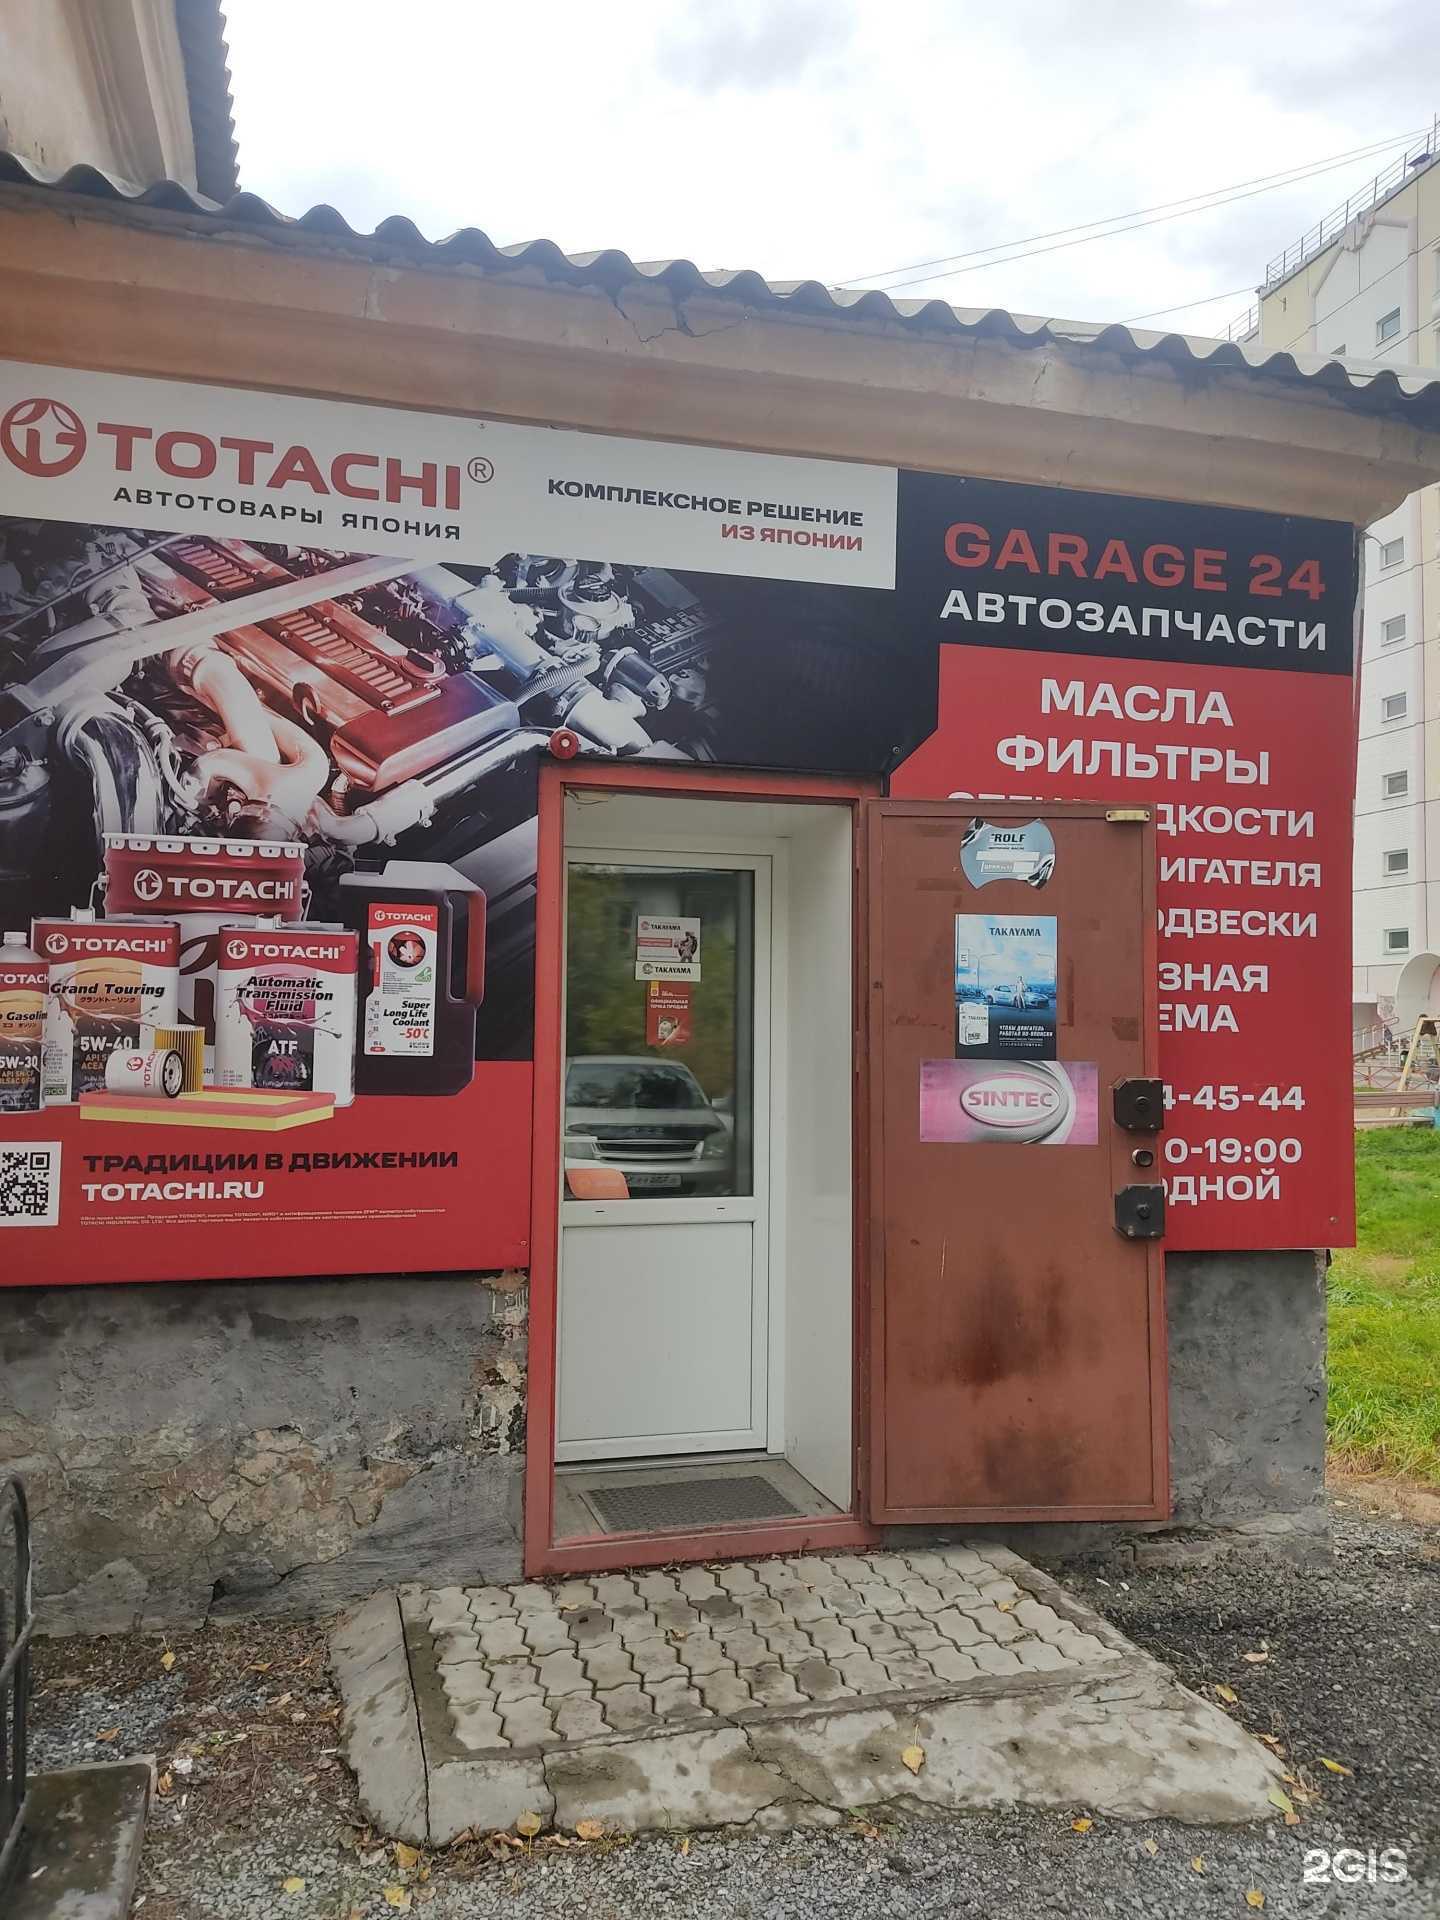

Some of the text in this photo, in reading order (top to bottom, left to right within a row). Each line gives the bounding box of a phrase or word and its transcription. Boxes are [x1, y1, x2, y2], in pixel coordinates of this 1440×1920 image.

[548, 478, 863, 527] КОМПЛЕКСНОЕ РЕШЕНИЕ
[114, 487, 461, 541] АВТОТОВАРЫ ЯПОНИЯ
[721, 523, 863, 552] ИЗ ЯПОНИИ
[944, 522, 1326, 600] GARAGE 24
[939, 589, 1327, 652] АВТОЗАПЧАСТИ
[1041, 678, 1234, 728] МАСЛА
[996, 735, 1270, 786] ФИЛЬТРЫ
[992, 833, 1027, 843] ROLF
[167, 877, 294, 900] TOTACHI
[387, 912, 431, 921] TOTACHI
[1158, 908, 1317, 939] ДВЕСКИ
[989, 927, 1042, 937] TAKAYAMA
[72, 938, 166, 953] TOTACHI
[250, 943, 340, 960] TOTACHI
[654, 966, 692, 974] TAKAYAMA
[50, 983, 165, 998] Grand Touring
[247, 976, 324, 989] Automatic
[236, 988, 333, 1001] Transmission
[266, 1000, 303, 1011] Fluid
[401, 1001, 430, 1010] Super
[383, 1009, 428, 1019] Long Life
[393, 1018, 430, 1027] Coolant
[80, 1036, 133, 1052] 5W-40
[268, 1040, 298, 1055] ATF
[968, 1090, 1053, 1108] SINTEC
[83, 1152, 459, 1175] ТРАДИЦИИ В ДВИЖЕНИИ
[82, 1181, 265, 1202] TOTACHI.RU
[1163, 1168, 1280, 1206] ДНОЙ
